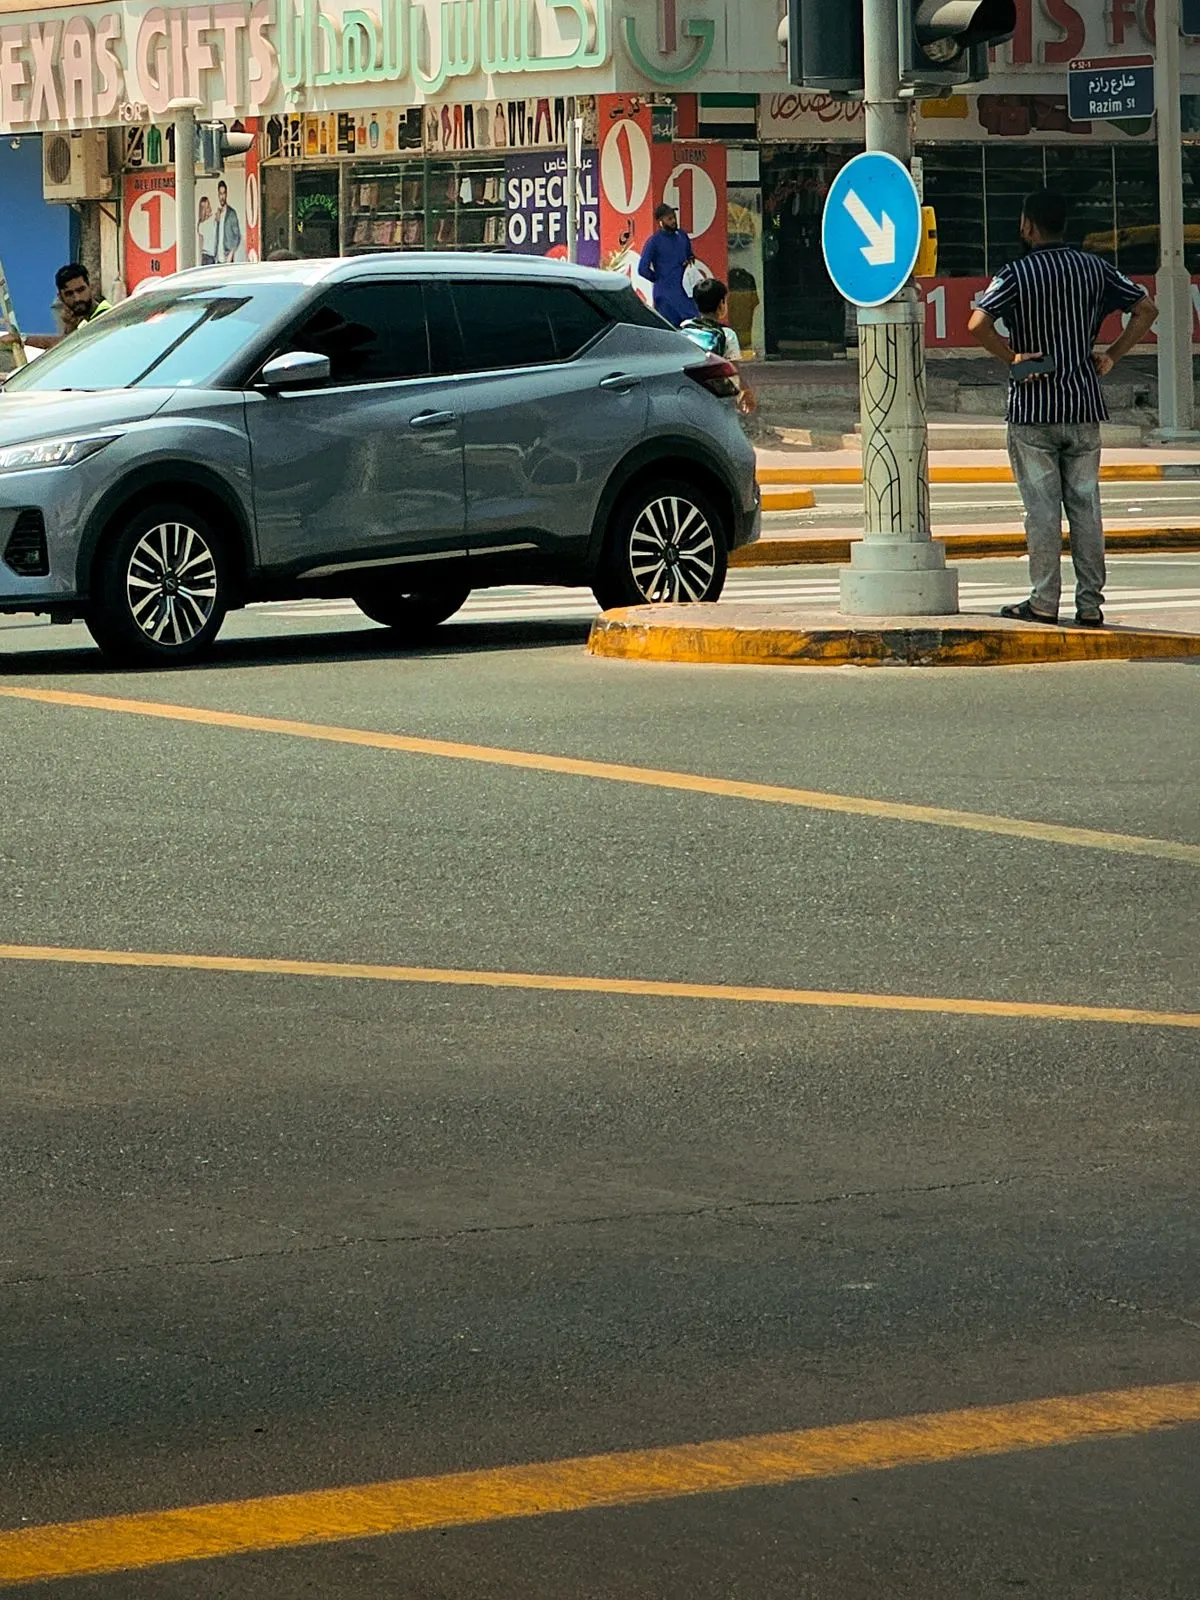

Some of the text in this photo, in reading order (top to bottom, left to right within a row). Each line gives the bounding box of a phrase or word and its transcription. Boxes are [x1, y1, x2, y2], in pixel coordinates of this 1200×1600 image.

[1110, 74, 1136, 95] شارع
[118, 101, 144, 122] FOR
[1089, 98, 1136, 114] Razim St
[673, 168, 693, 234] 1
[140, 195, 161, 249] 1
[508, 211, 599, 245] OFFR
